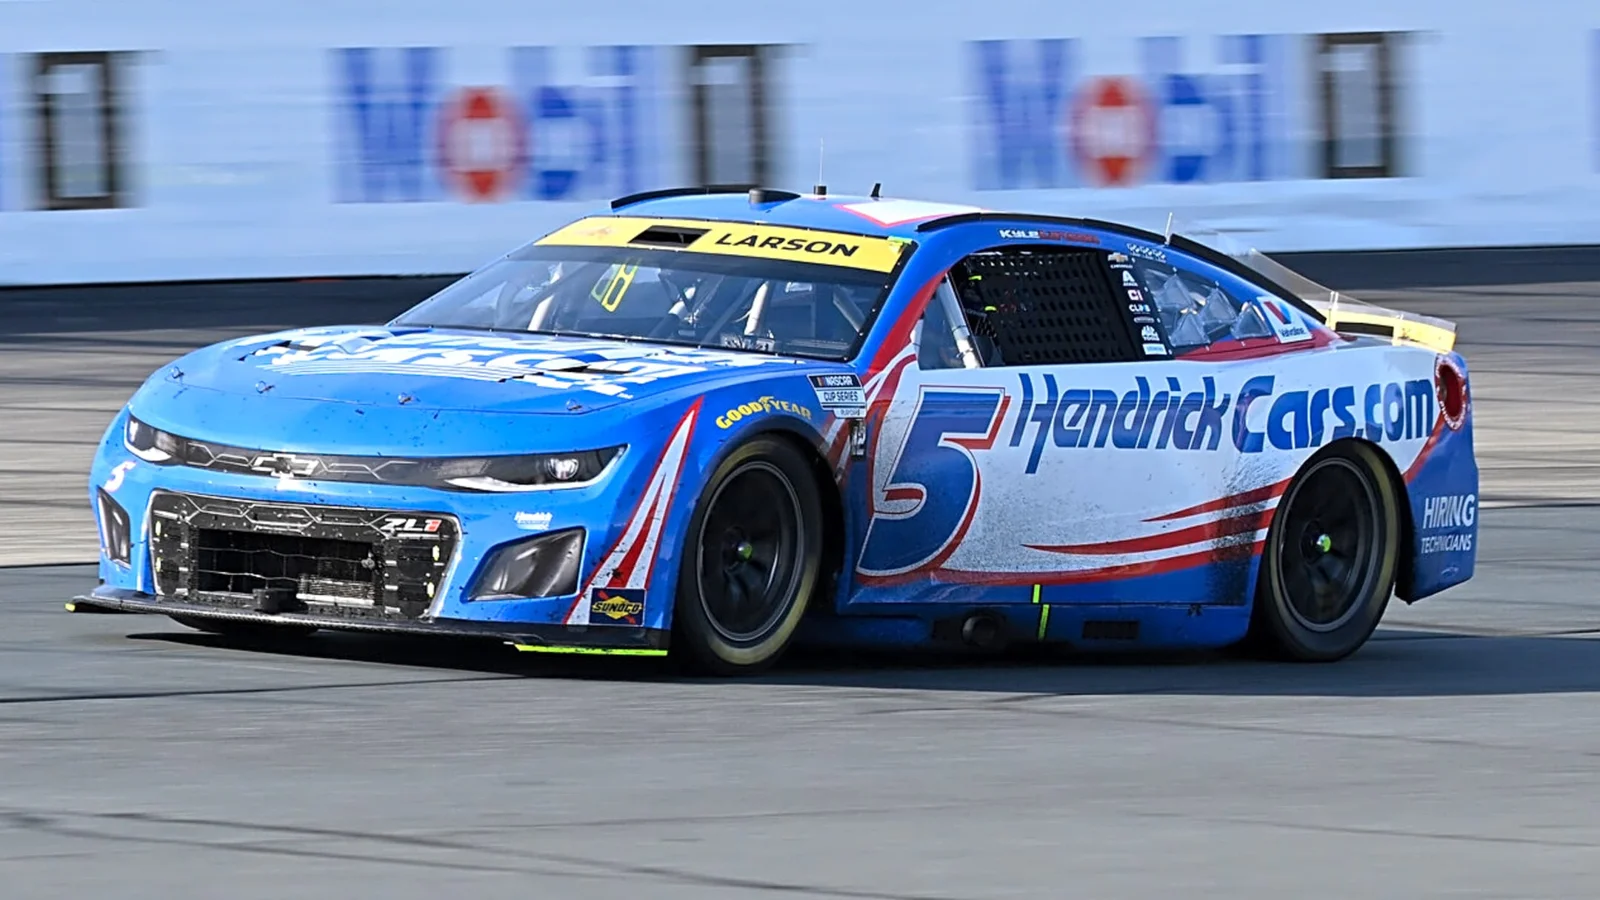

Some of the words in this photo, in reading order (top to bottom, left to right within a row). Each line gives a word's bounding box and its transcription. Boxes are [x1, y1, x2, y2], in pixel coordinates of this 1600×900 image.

[715, 233, 860, 258] LARSON
[825, 375, 854, 386] NASCAR
[823, 391, 836, 402] CUP
[836, 390, 859, 402] SERIES
[715, 396, 813, 430] GOODYEAR
[103, 459, 137, 492] 5
[857, 385, 1008, 577] 5
[1422, 494, 1476, 530] HIRING
[380, 517, 443, 533] ZL1
[1421, 534, 1473, 554] TECHNICIANS
[593, 602, 641, 613] SUNOCO
